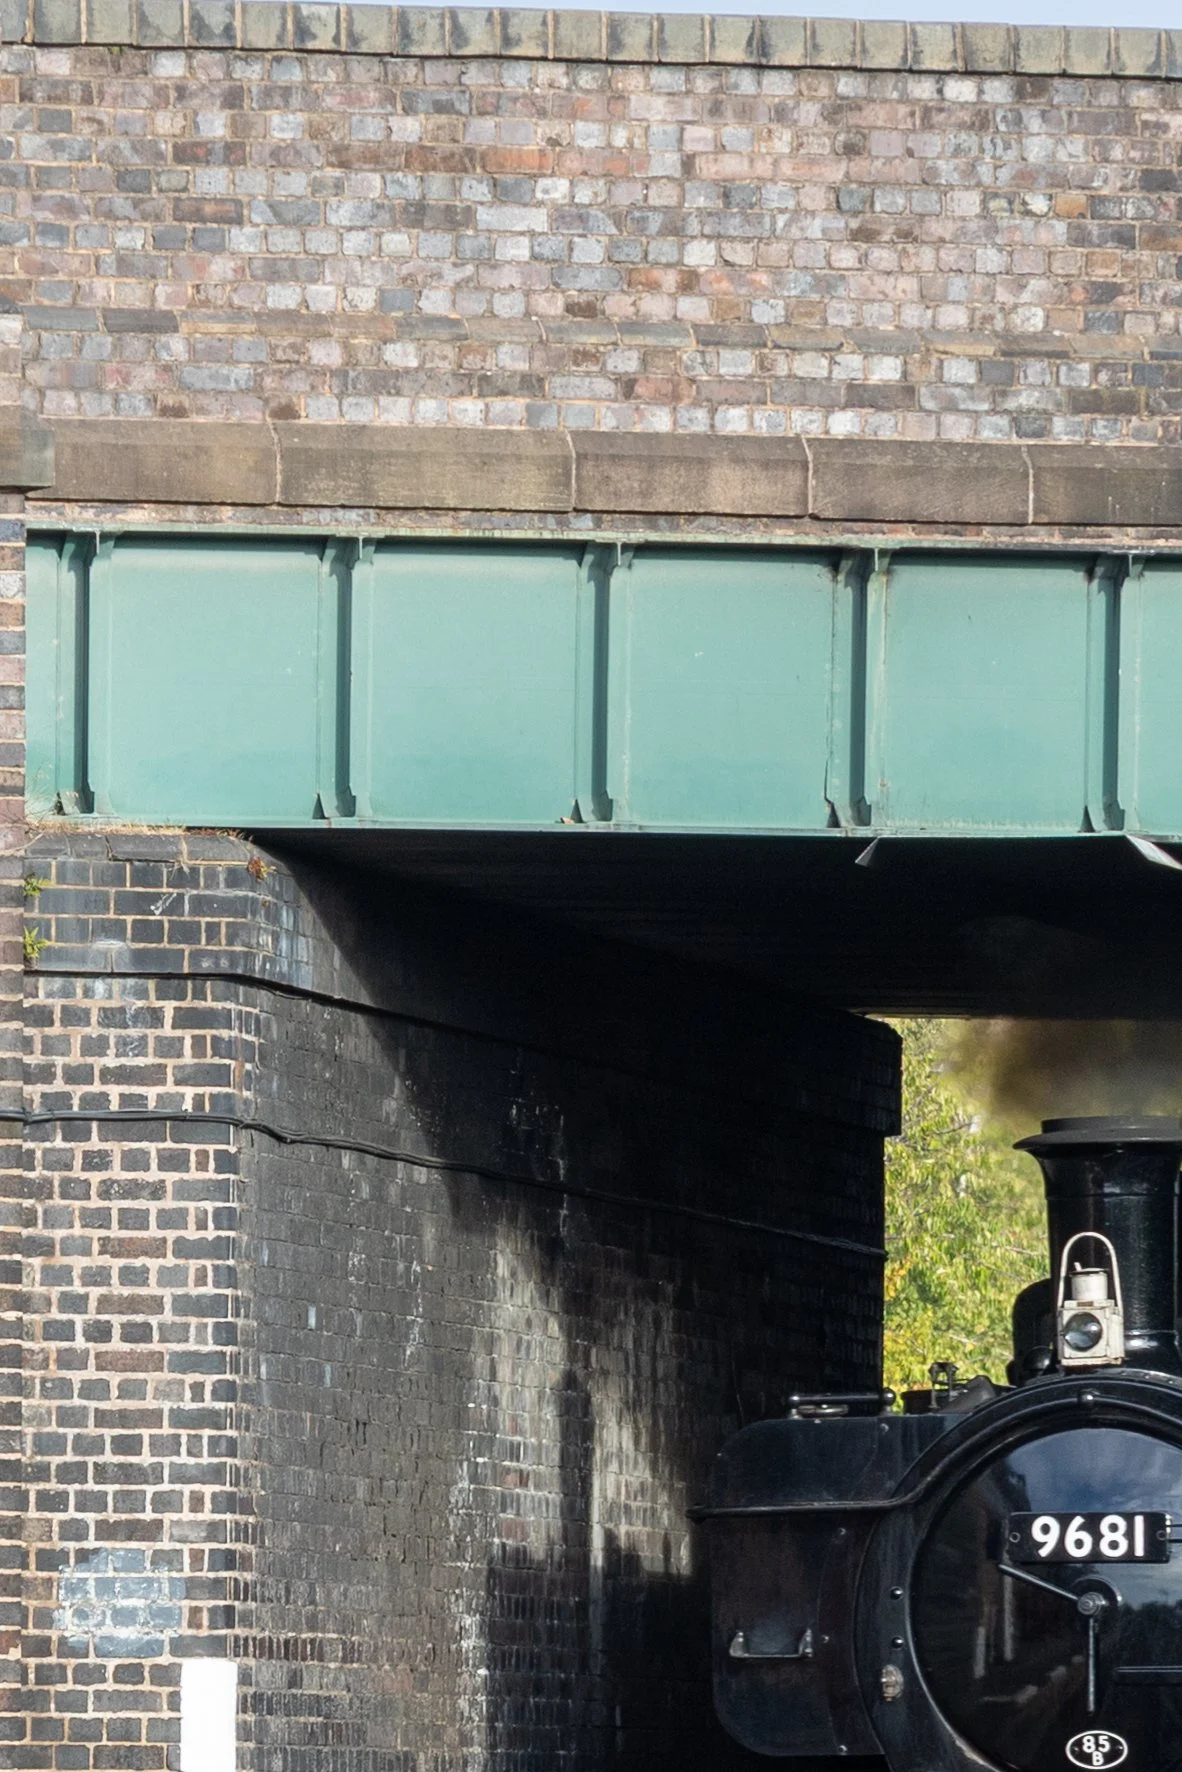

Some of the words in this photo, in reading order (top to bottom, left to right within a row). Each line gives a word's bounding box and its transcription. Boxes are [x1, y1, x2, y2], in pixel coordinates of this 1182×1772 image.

[1031, 1515, 1145, 1558] 9681
[1082, 1735, 1110, 1753] 85
[1092, 1751, 1104, 1766] B
